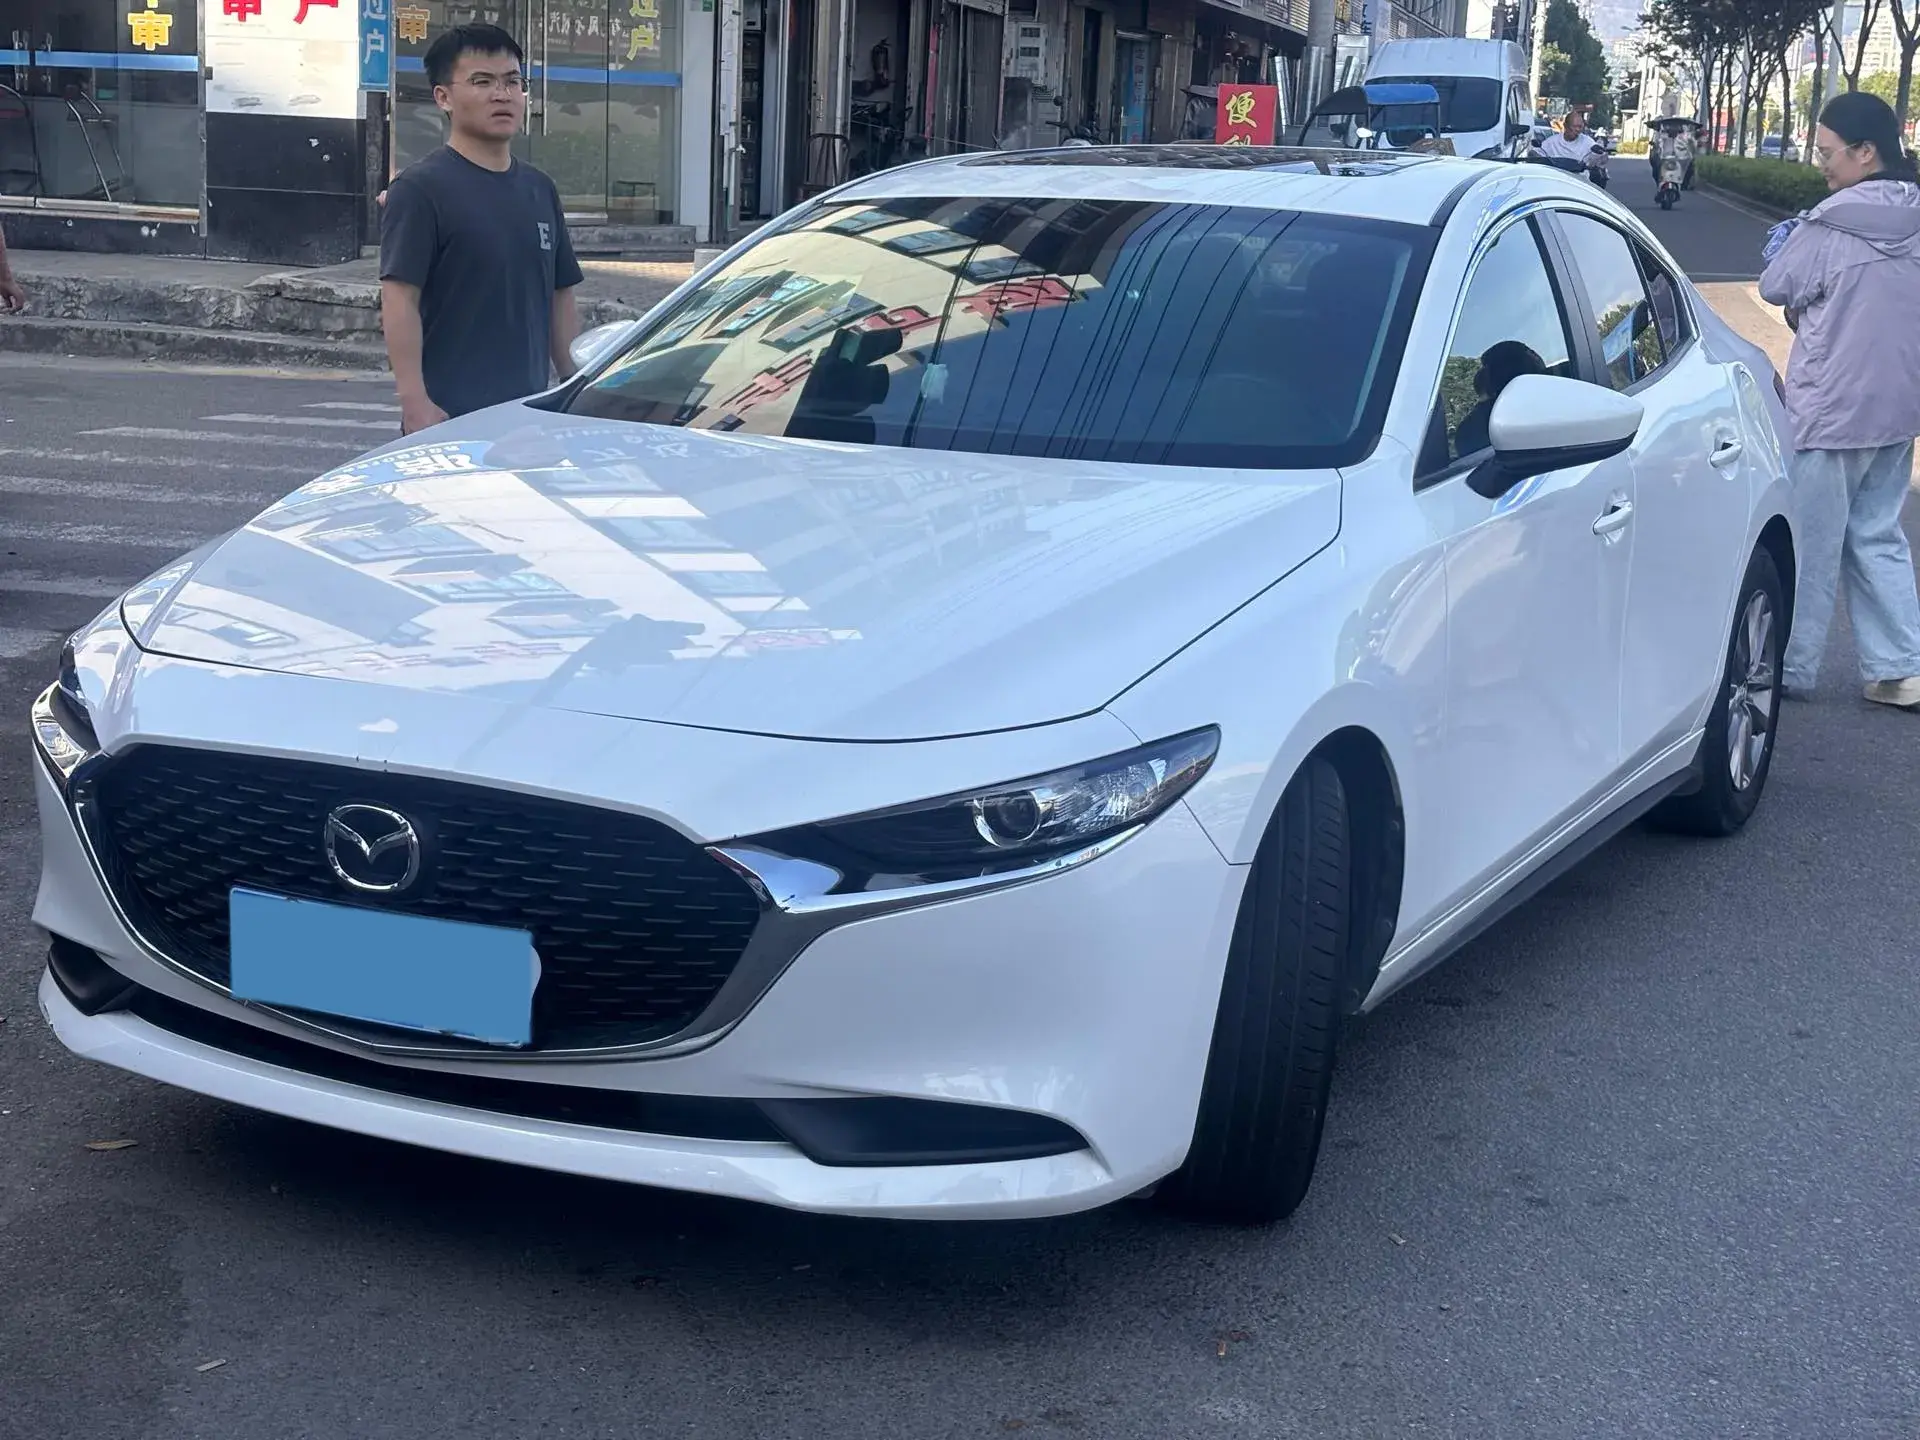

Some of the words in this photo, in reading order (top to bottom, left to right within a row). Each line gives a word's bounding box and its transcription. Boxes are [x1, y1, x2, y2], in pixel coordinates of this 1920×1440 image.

[127, 0, 173, 51] 审
[396, 3, 431, 45] 审
[1224, 90, 1258, 146] 便
[537, 221, 552, 250] E
